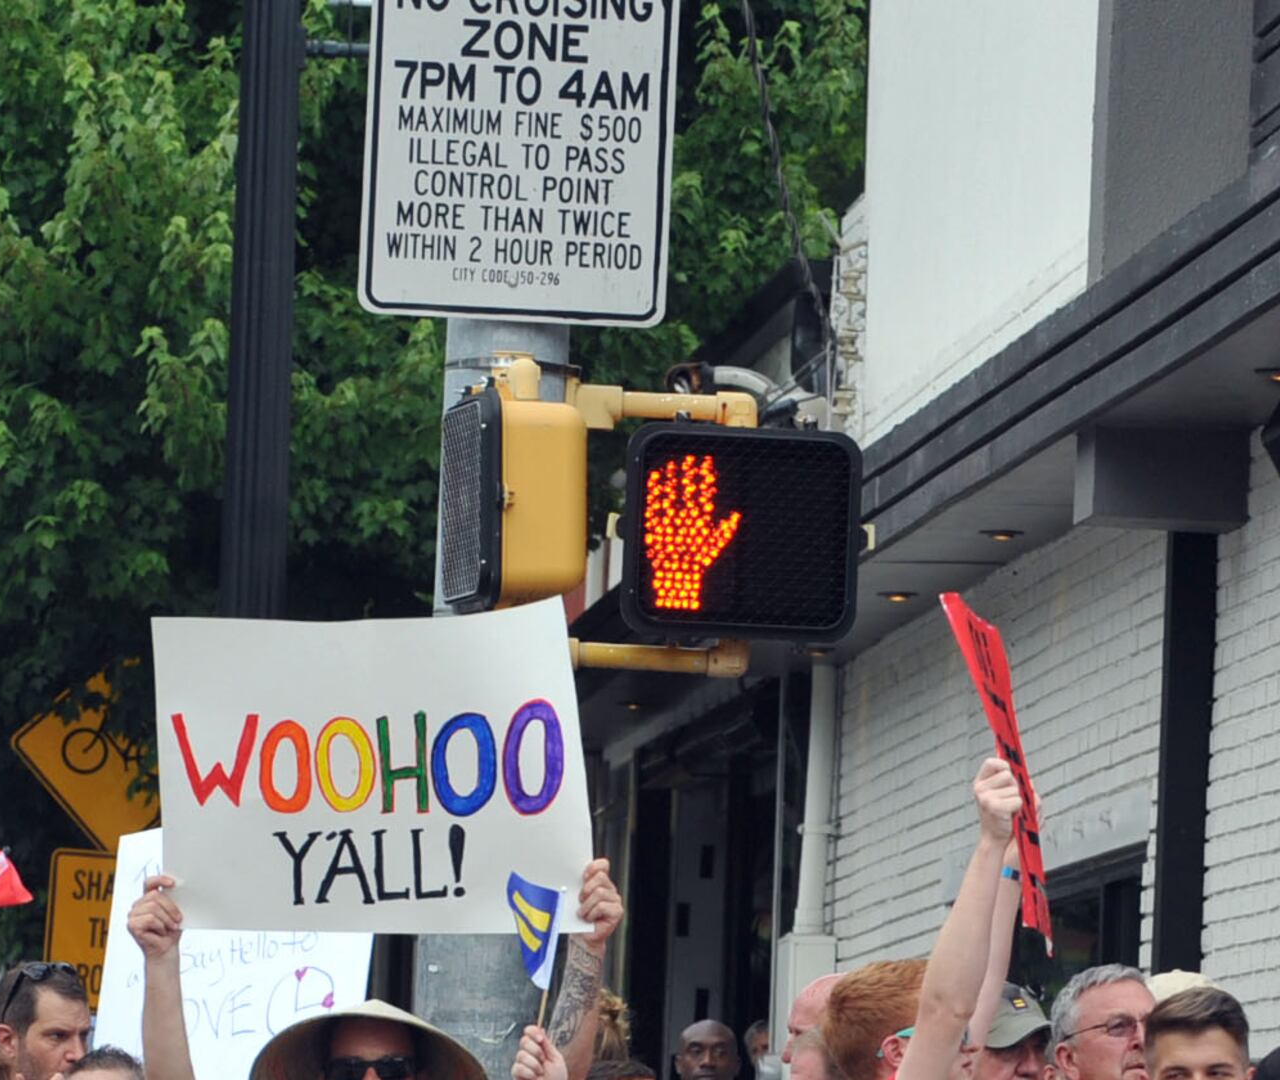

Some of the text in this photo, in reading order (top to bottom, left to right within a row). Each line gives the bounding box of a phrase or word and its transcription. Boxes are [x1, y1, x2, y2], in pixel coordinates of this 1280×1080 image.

[461, 19, 589, 63] ZONE
[394, 59, 650, 111] 7PM TO 4AM
[398, 105, 642, 144] MAXIMUM FINE $500
[408, 137, 625, 174] ILLEGAL TO PASS
[414, 169, 614, 205] CONTROL POINT
[396, 201, 631, 238] MORE THAN TWICE
[387, 232, 642, 270] WITHIN 2 HOUR PERIOD
[452, 267, 475, 282] CITY
[482, 268, 509, 284] CODE
[171, 697, 565, 817] WOOHOO
[72, 869, 115, 902] SHA
